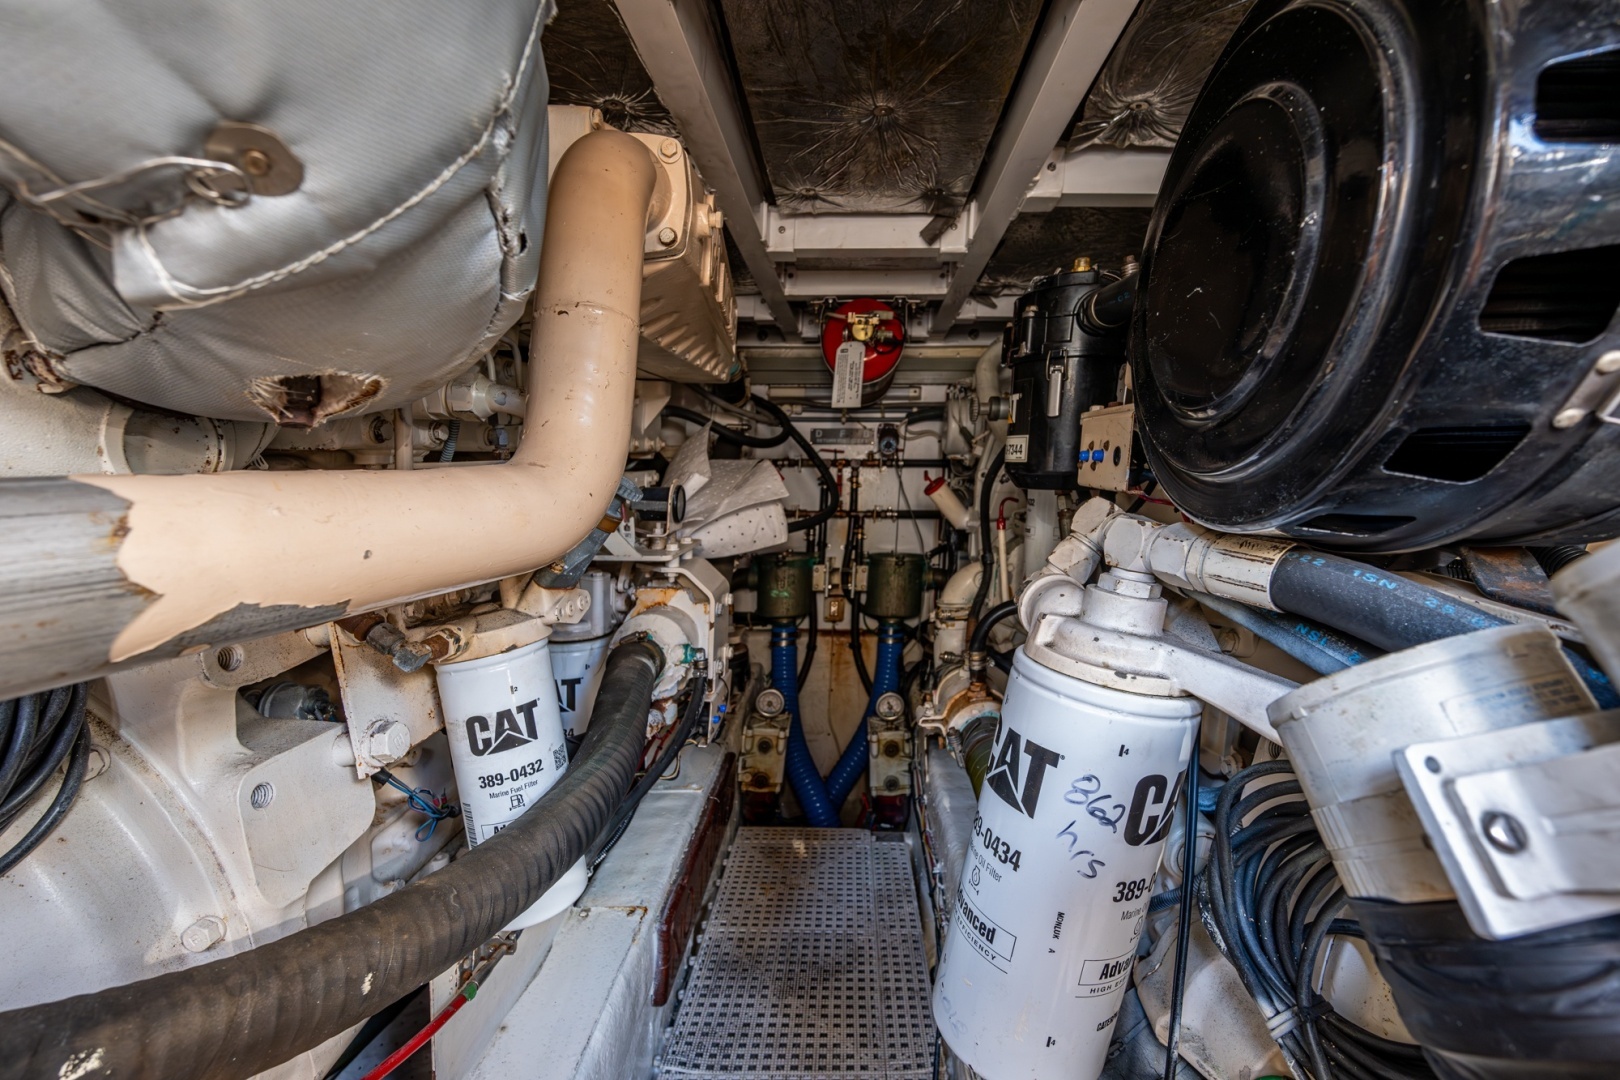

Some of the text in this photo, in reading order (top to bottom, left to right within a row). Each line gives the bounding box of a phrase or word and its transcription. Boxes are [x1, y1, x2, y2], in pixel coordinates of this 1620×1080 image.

[465, 698, 538, 757] CAT
[478, 758, 544, 789] 389-0432
[986, 713, 1061, 819] AT
[489, 779, 538, 799] Marine Fuel Filter
[1063, 773, 1126, 834] 862
[1056, 819, 1106, 879] hrs
[986, 862, 1002, 882] Filter
[1112, 871, 1157, 903] 389-0
[1089, 985, 1112, 994] HIGH
